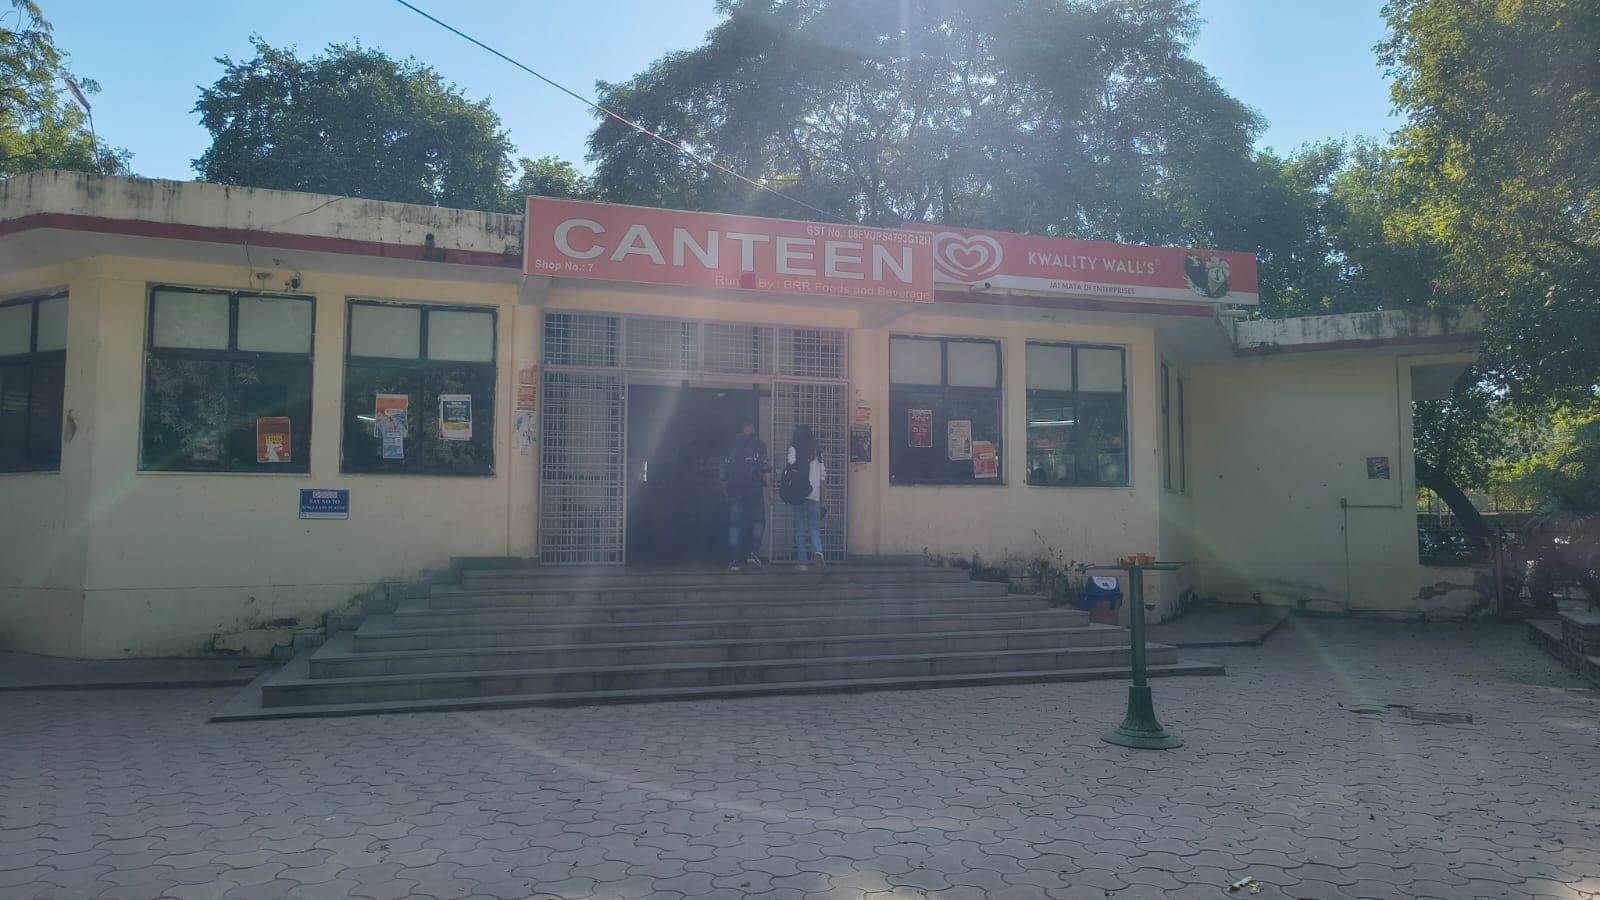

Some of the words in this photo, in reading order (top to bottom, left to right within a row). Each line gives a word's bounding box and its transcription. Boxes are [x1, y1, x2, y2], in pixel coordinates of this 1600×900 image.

[806, 225, 826, 236] GST
[553, 217, 914, 284] CANTEEN
[535, 259, 562, 272] Shop
[588, 263, 594, 272] 7
[1027, 251, 1098, 270] KWALITY
[715, 275, 741, 286] Run
[783, 280, 810, 291] BRR
[815, 282, 849, 294] Foods
[854, 285, 874, 296] and
[1049, 280, 1060, 289] JAI
[1062, 281, 1082, 290] MATA
[1092, 284, 1136, 295] ENTERPRISES
